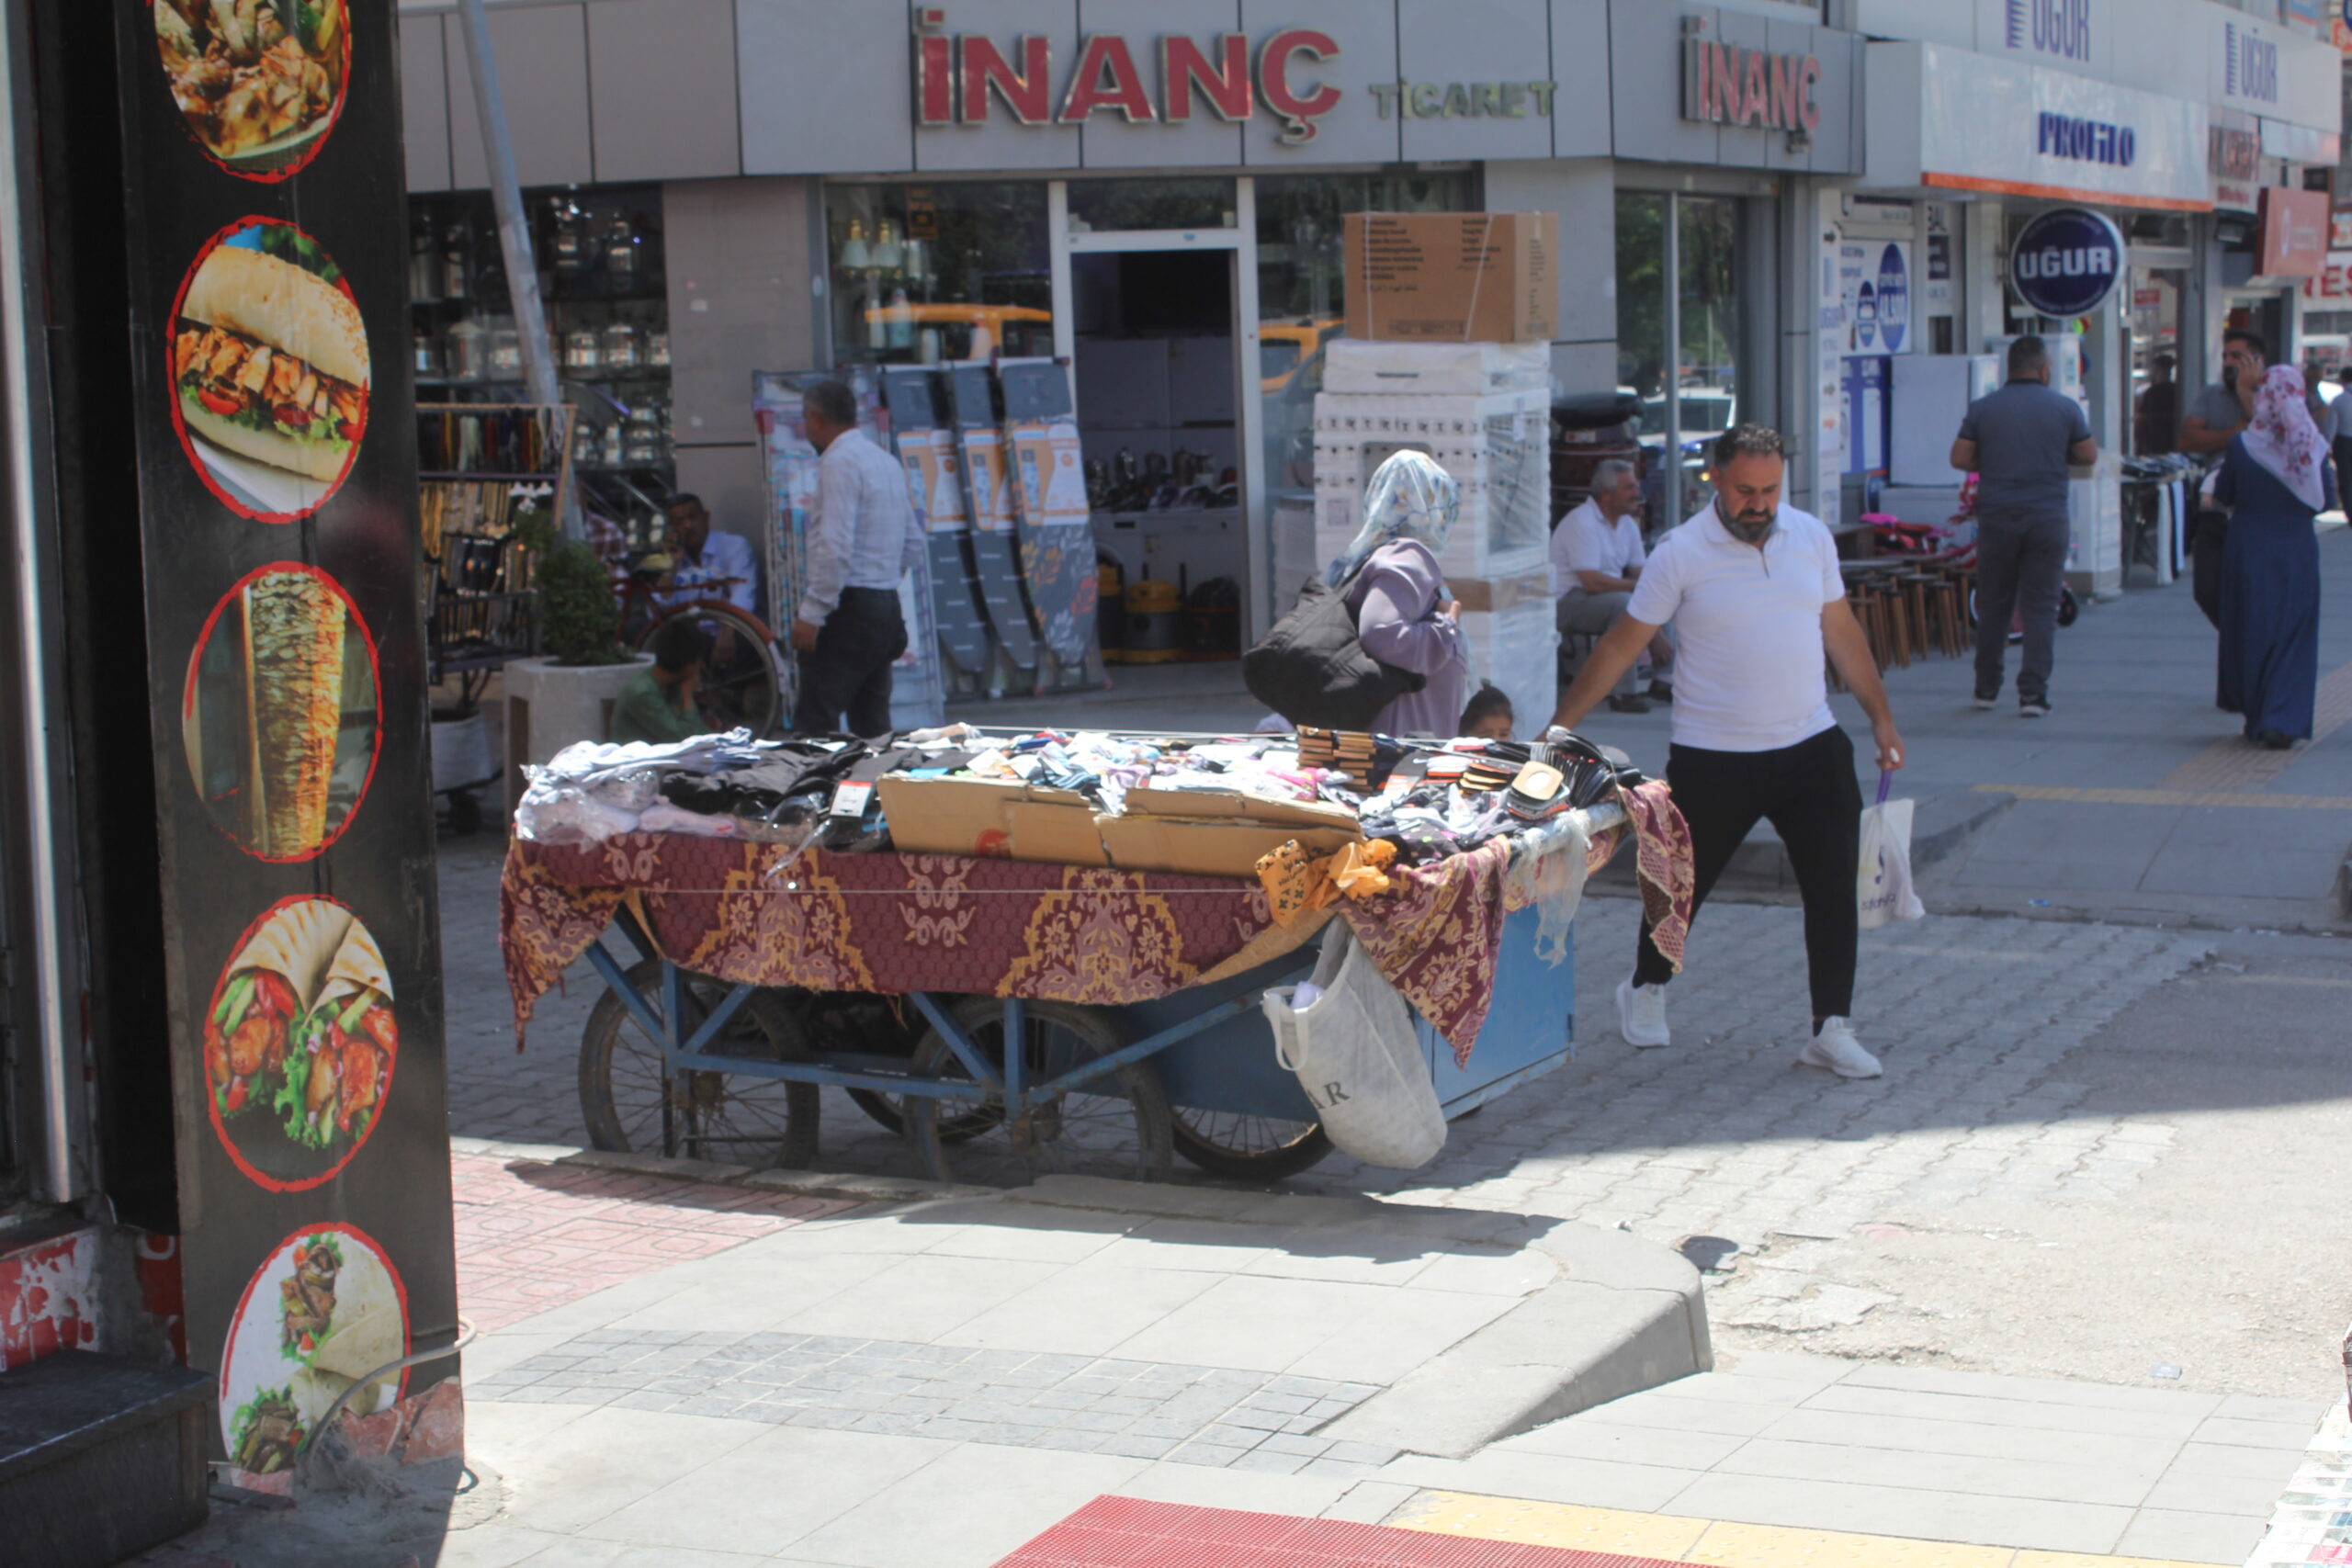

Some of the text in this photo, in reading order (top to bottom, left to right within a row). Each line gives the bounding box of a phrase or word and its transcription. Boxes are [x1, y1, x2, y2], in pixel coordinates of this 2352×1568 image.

[918, 6, 1557, 144] İNANÇ TİCARET
[1692, 16, 1822, 154] İNANÇ
[2018, 245, 2113, 280] UĞUR
